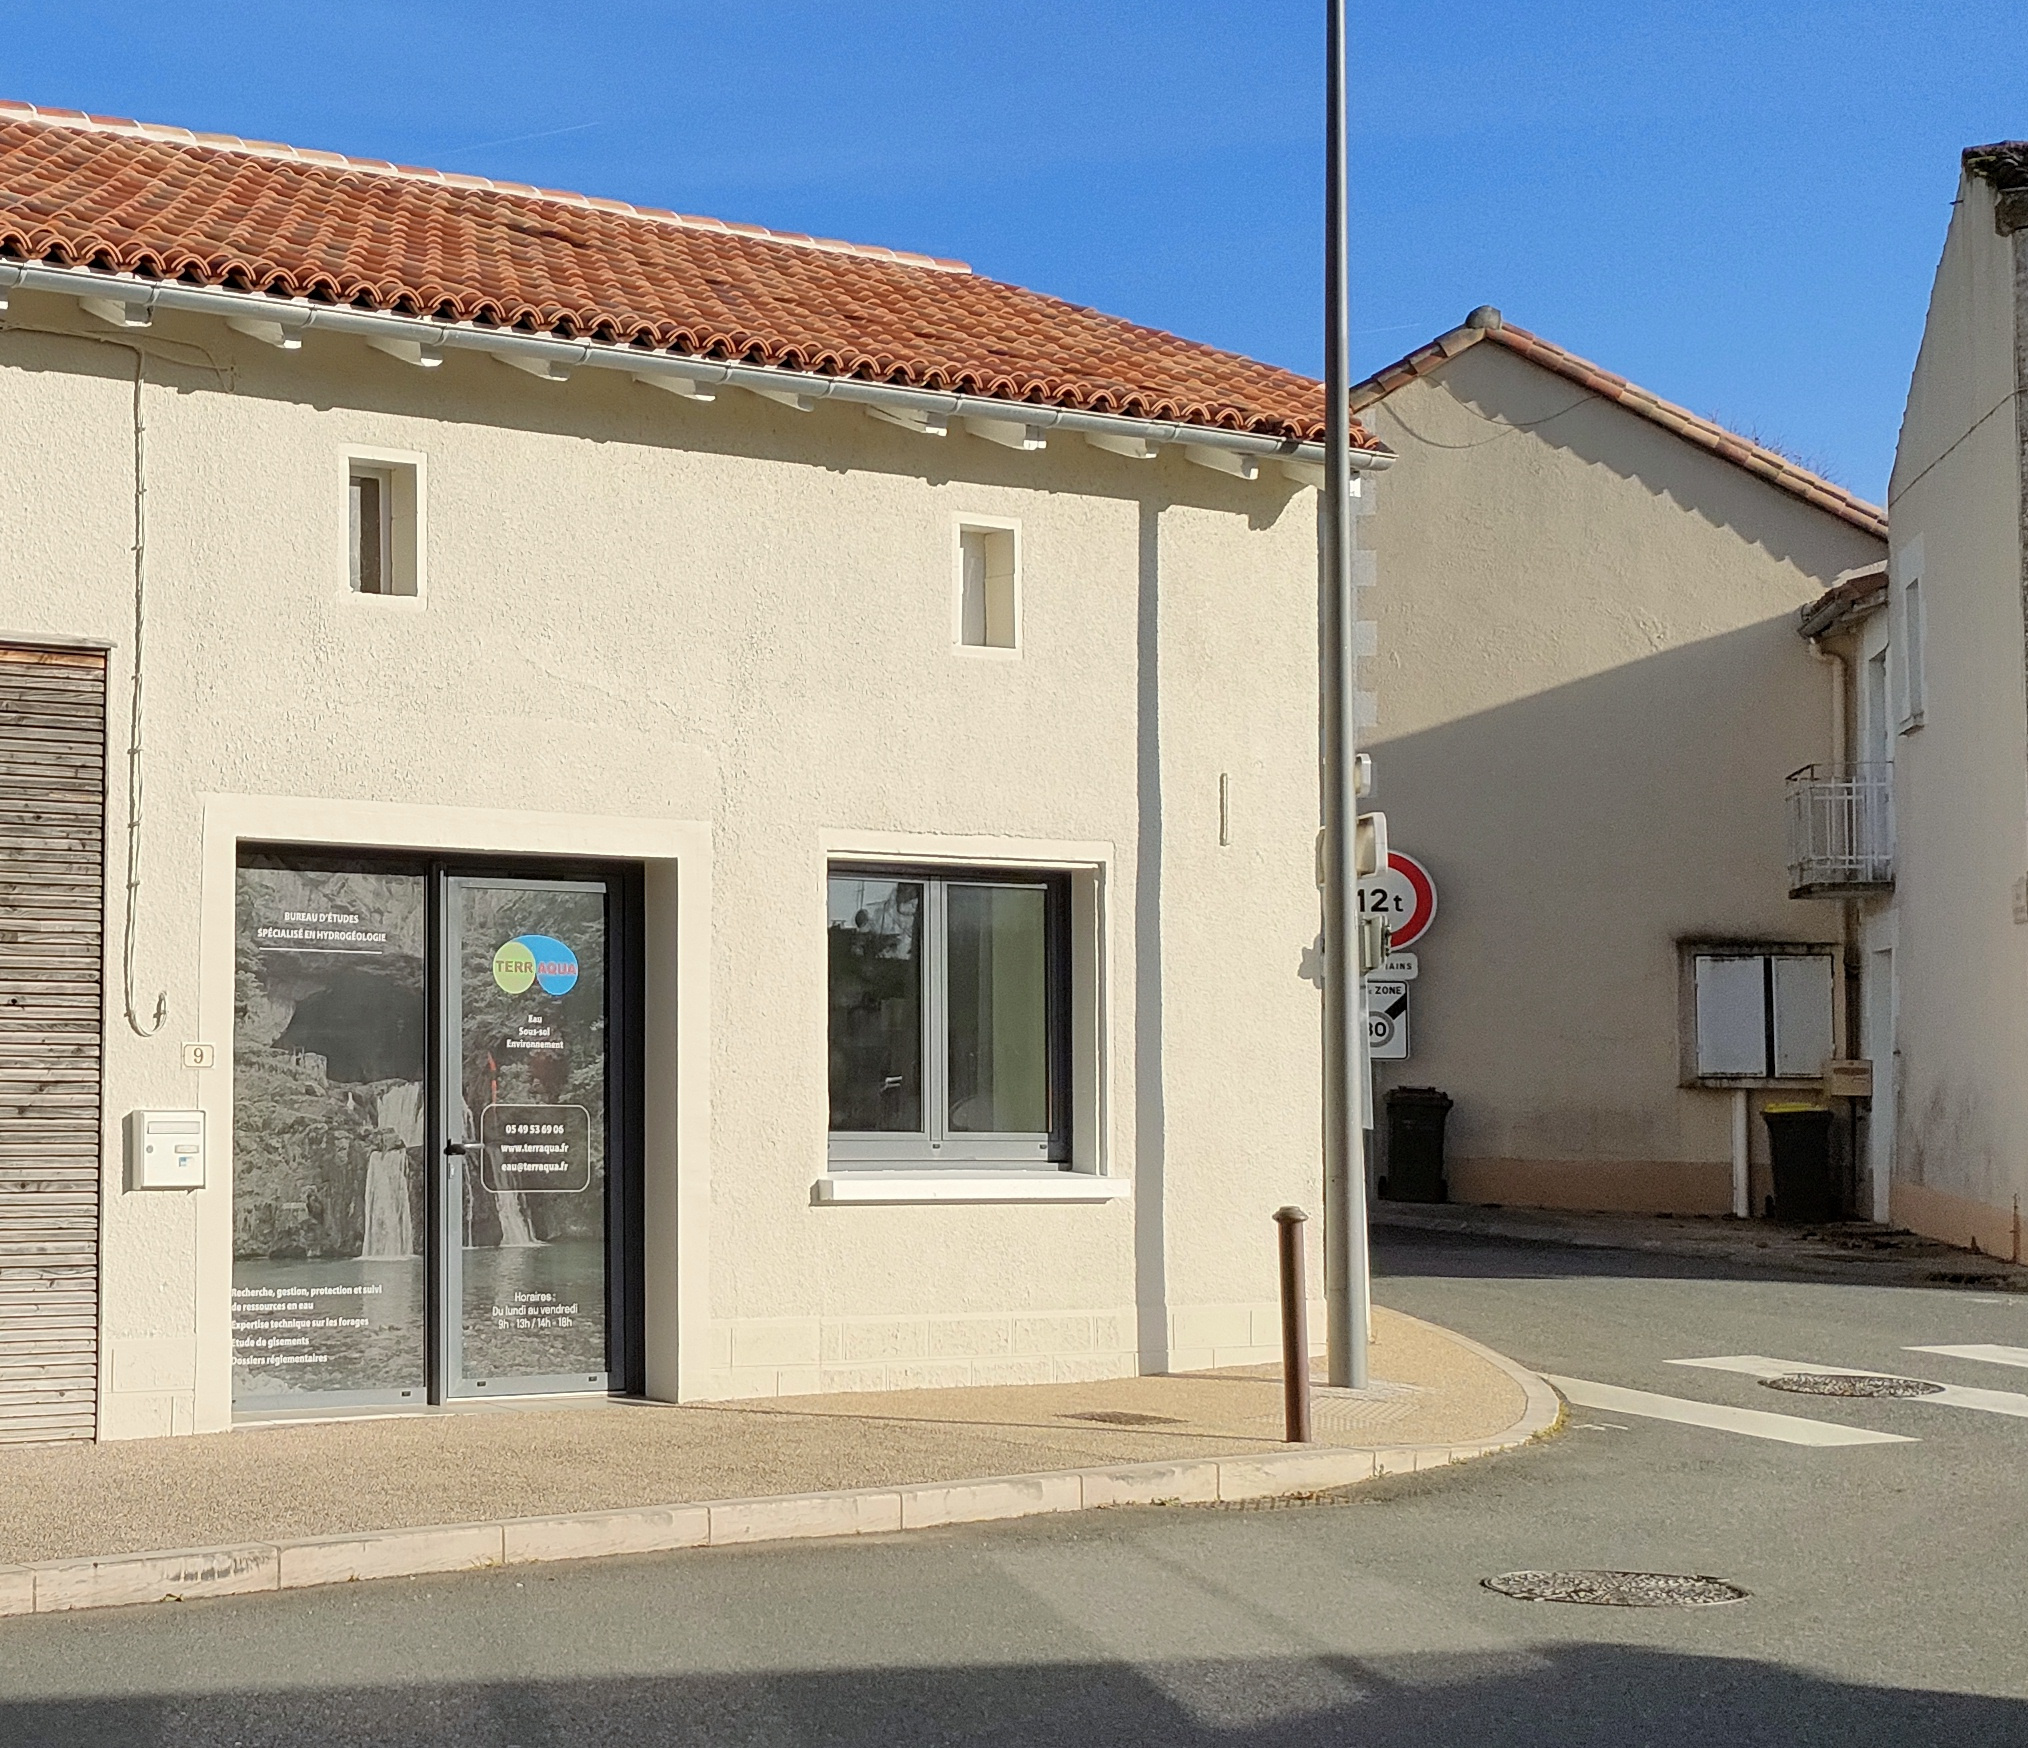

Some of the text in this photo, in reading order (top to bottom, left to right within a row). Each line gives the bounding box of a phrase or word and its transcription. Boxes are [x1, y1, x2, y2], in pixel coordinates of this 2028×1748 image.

[1357, 888, 1404, 912] 12 t
[284, 911, 359, 924] BUREAU D'ÉTUDES
[257, 926, 387, 942] SPÉCIALISÉ EN HYDROGÉOLOGIE
[495, 960, 577, 975] TERR AQUA
[1375, 986, 1402, 995] ZONE
[528, 1014, 542, 1024] Eau
[518, 1026, 551, 1036] Sous-sol
[506, 1039, 564, 1049] Environnement
[193, 1047, 204, 1064] 9
[505, 1124, 517, 1135] 05
[517, 1124, 529, 1135] 49
[529, 1124, 541, 1135] 53
[553, 1124, 565, 1135] 06
[500, 1142, 570, 1155] www.terraqua.fr
[501, 1160, 569, 1174] eau@terraqua.fr
[231, 1284, 382, 1298] Recherche, gestion, protection et suivi
[231, 1302, 314, 1312] de ressources en eau
[492, 1303, 579, 1317] Du lundi au vendredi
[231, 1317, 369, 1332] Expertise technique sur les forages
[498, 1319, 510, 1330] 9h
[516, 1318, 531, 1329] 13h
[537, 1317, 551, 1328] 14h
[255, 1336, 267, 1347] de
[267, 1336, 309, 1349] gisements
[231, 1353, 328, 1367] Dossiers réglementaires
